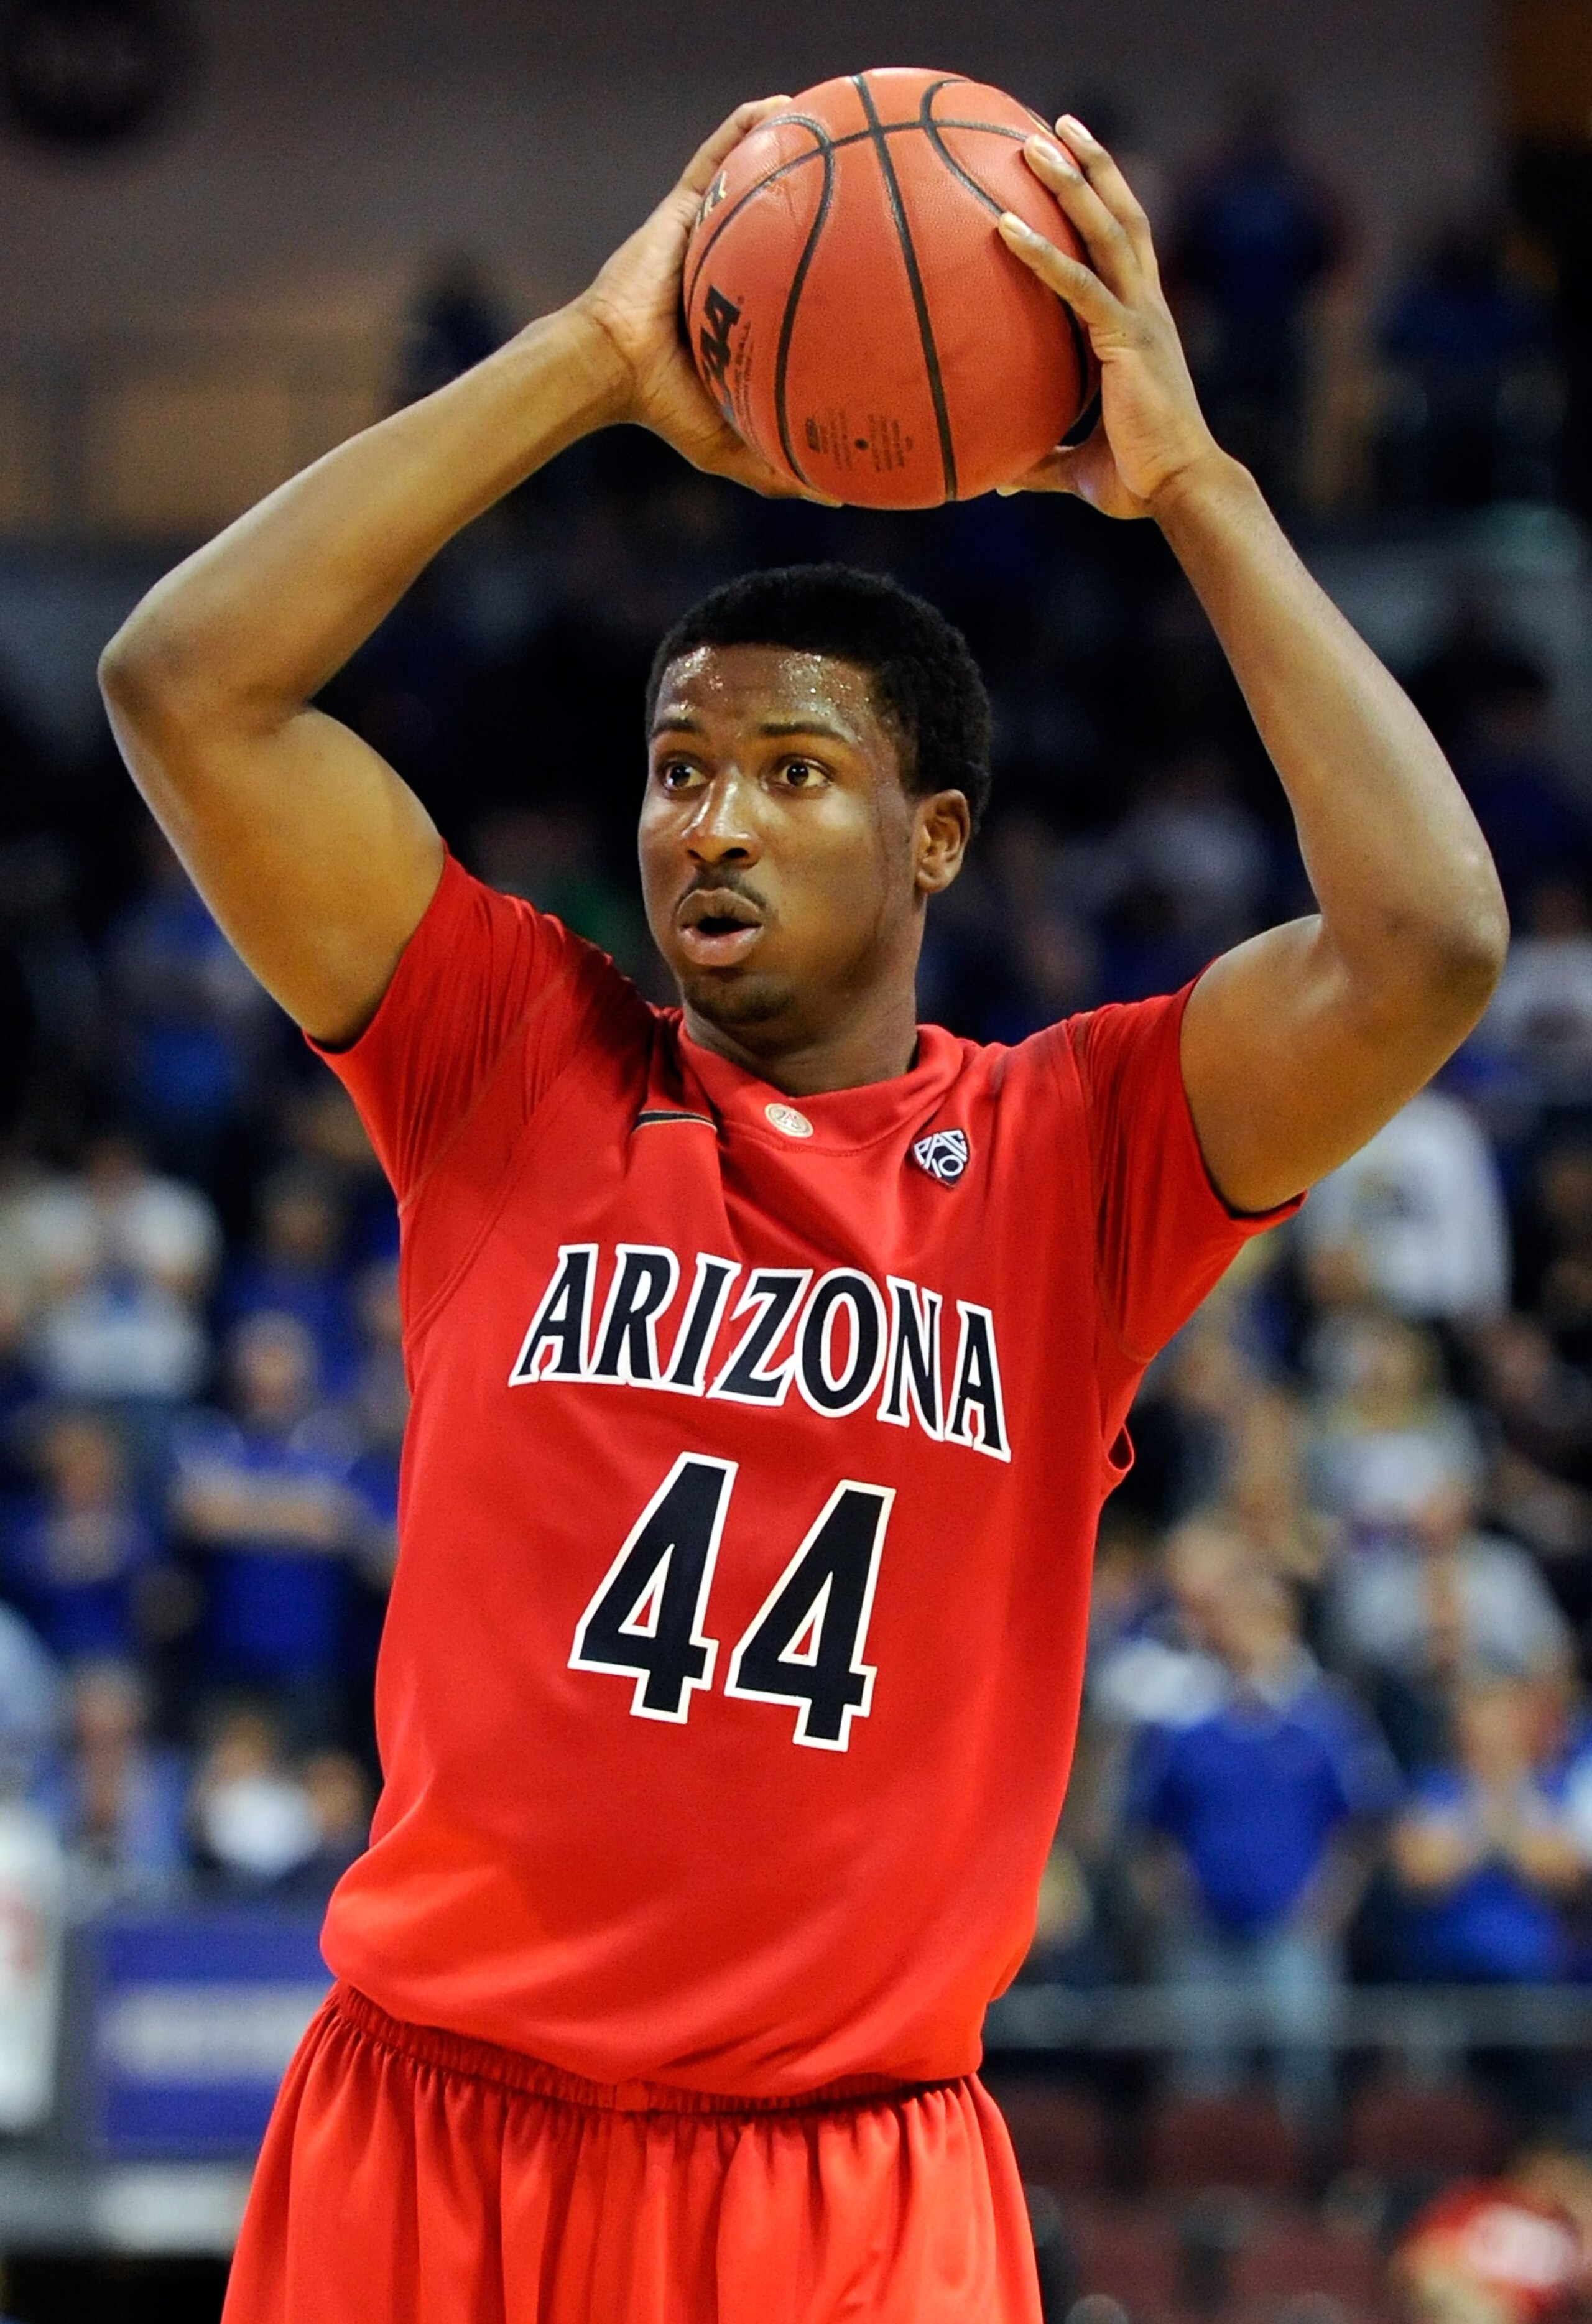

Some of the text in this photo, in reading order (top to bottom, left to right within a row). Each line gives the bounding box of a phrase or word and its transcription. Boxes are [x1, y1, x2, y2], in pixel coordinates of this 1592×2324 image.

[913, 1129, 968, 1170] PAC
[508, 1243, 1012, 1463] ARIZONA
[568, 1451, 896, 1752] 44
